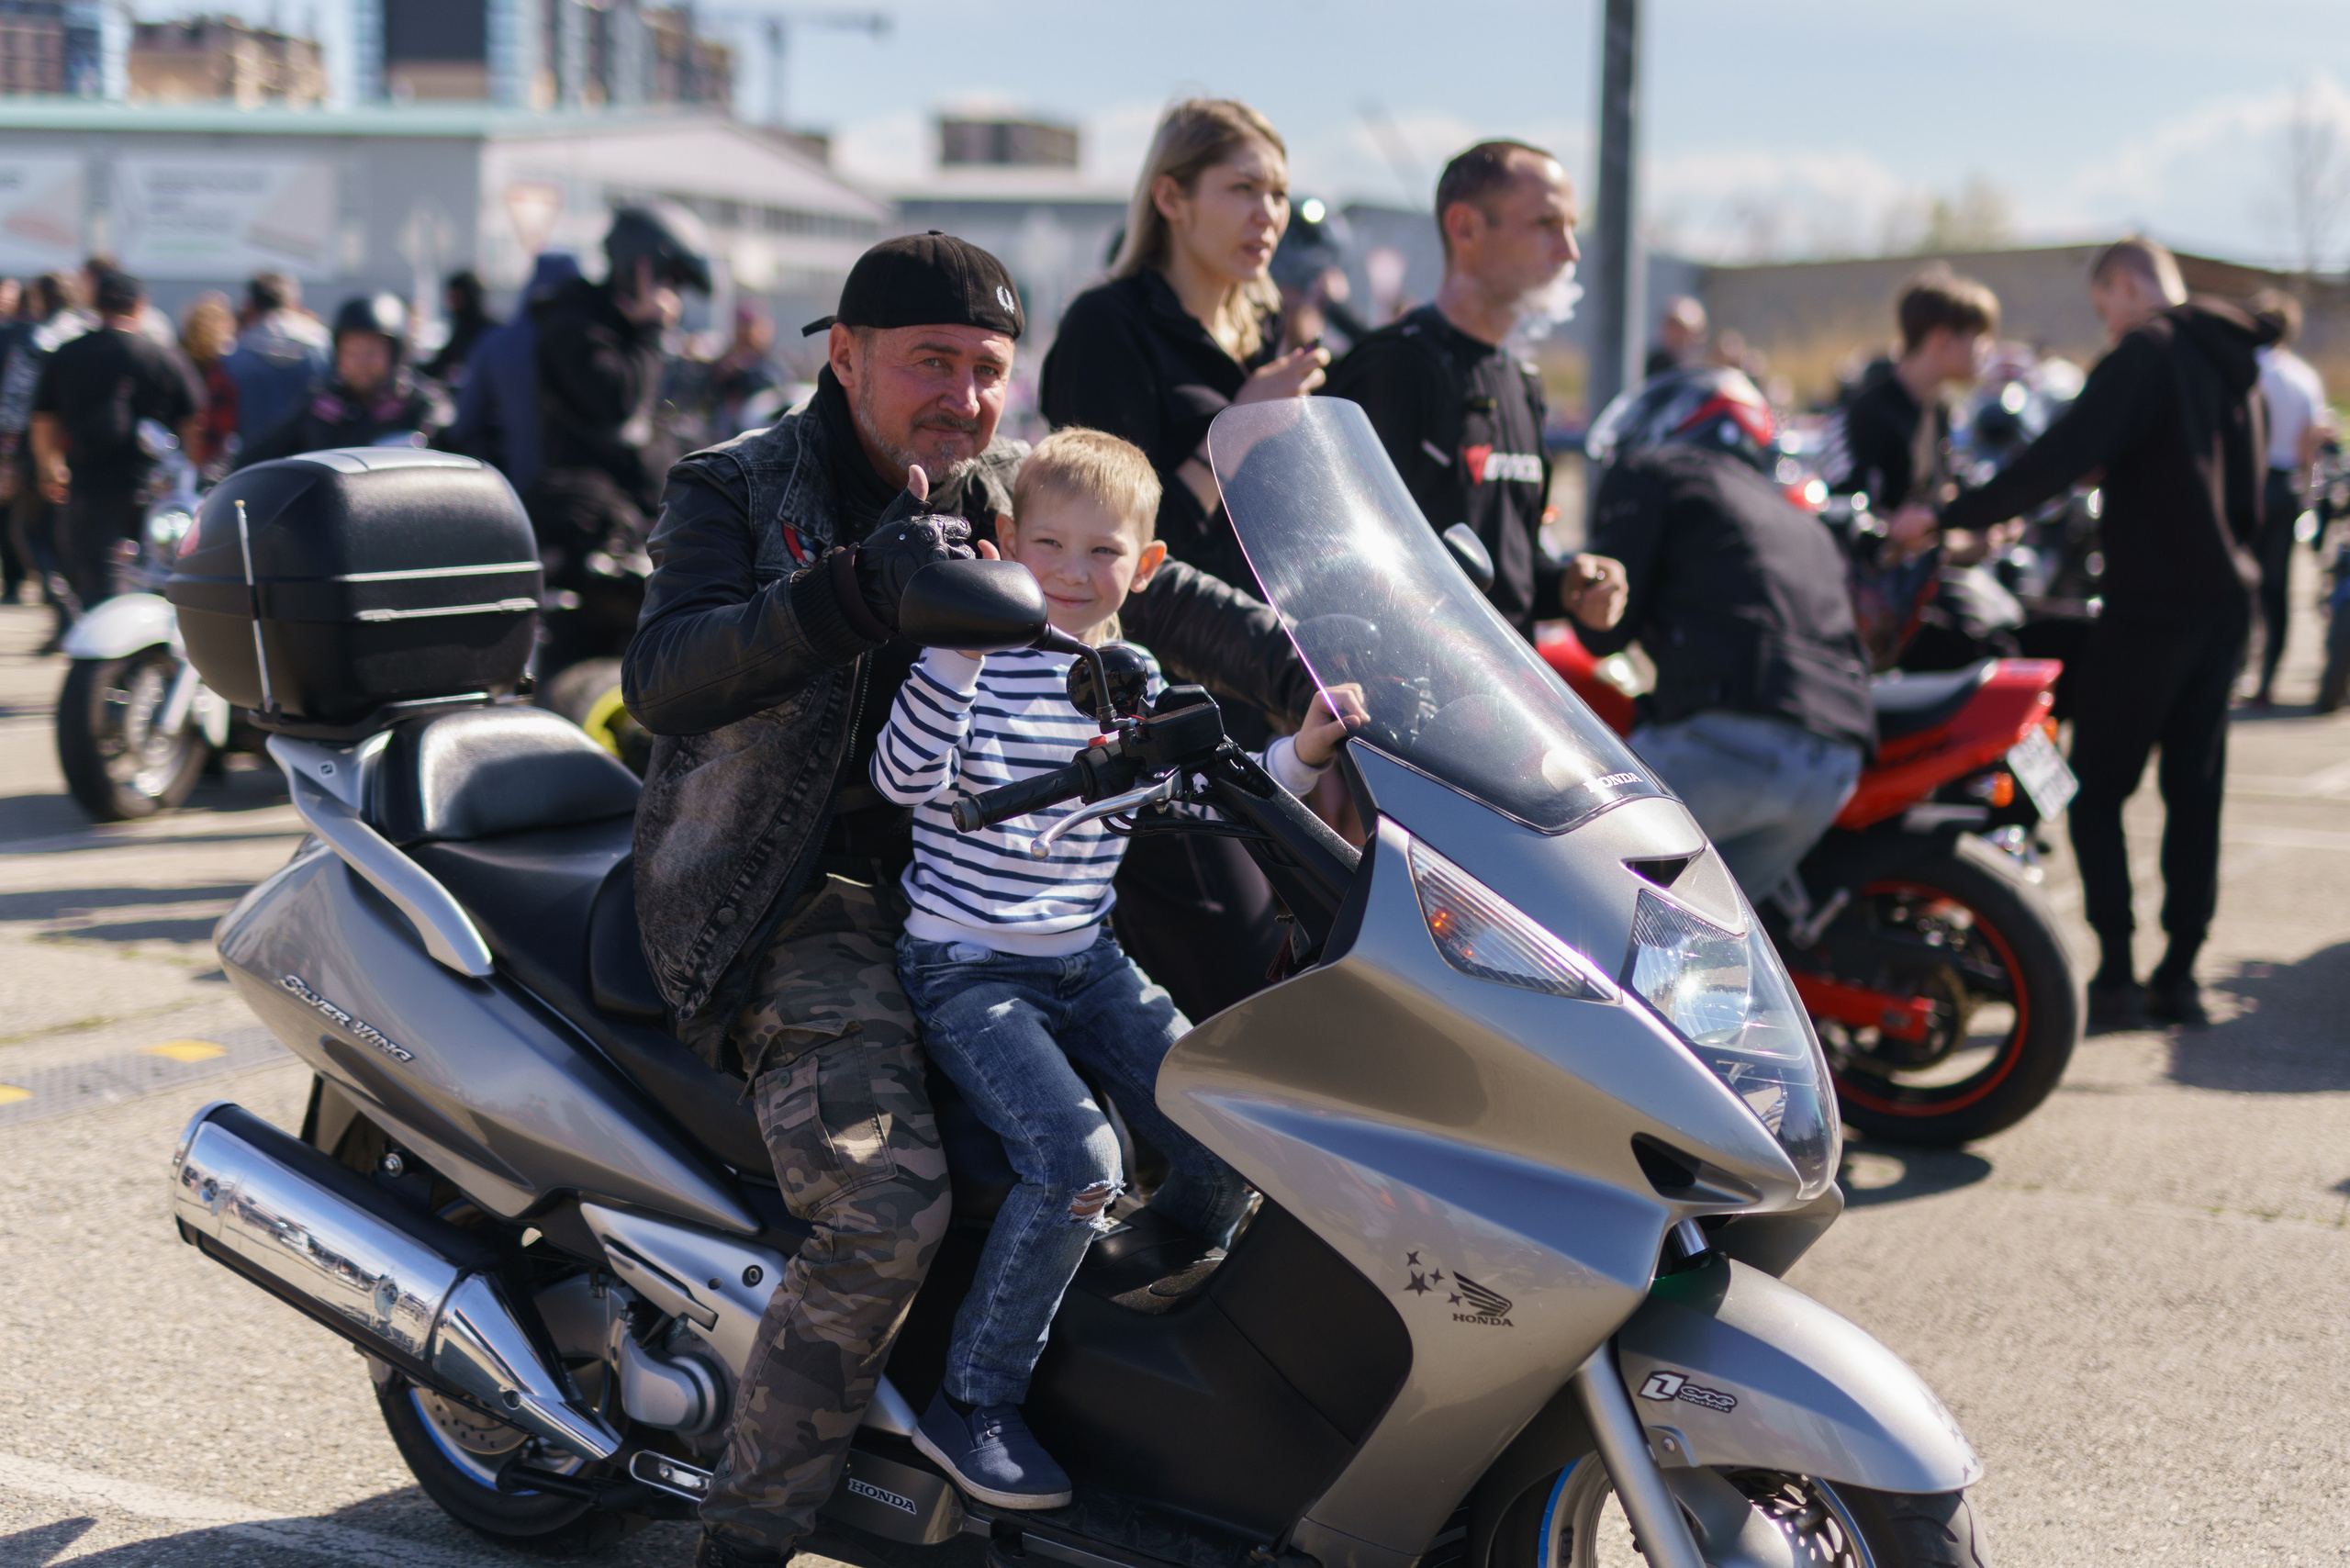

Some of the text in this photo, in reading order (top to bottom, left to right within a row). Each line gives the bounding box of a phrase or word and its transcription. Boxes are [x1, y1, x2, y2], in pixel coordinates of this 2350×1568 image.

[353, 1020, 415, 1063] WING
[1452, 1313, 1514, 1327] HONDA
[849, 1479, 916, 1514] HONDA
